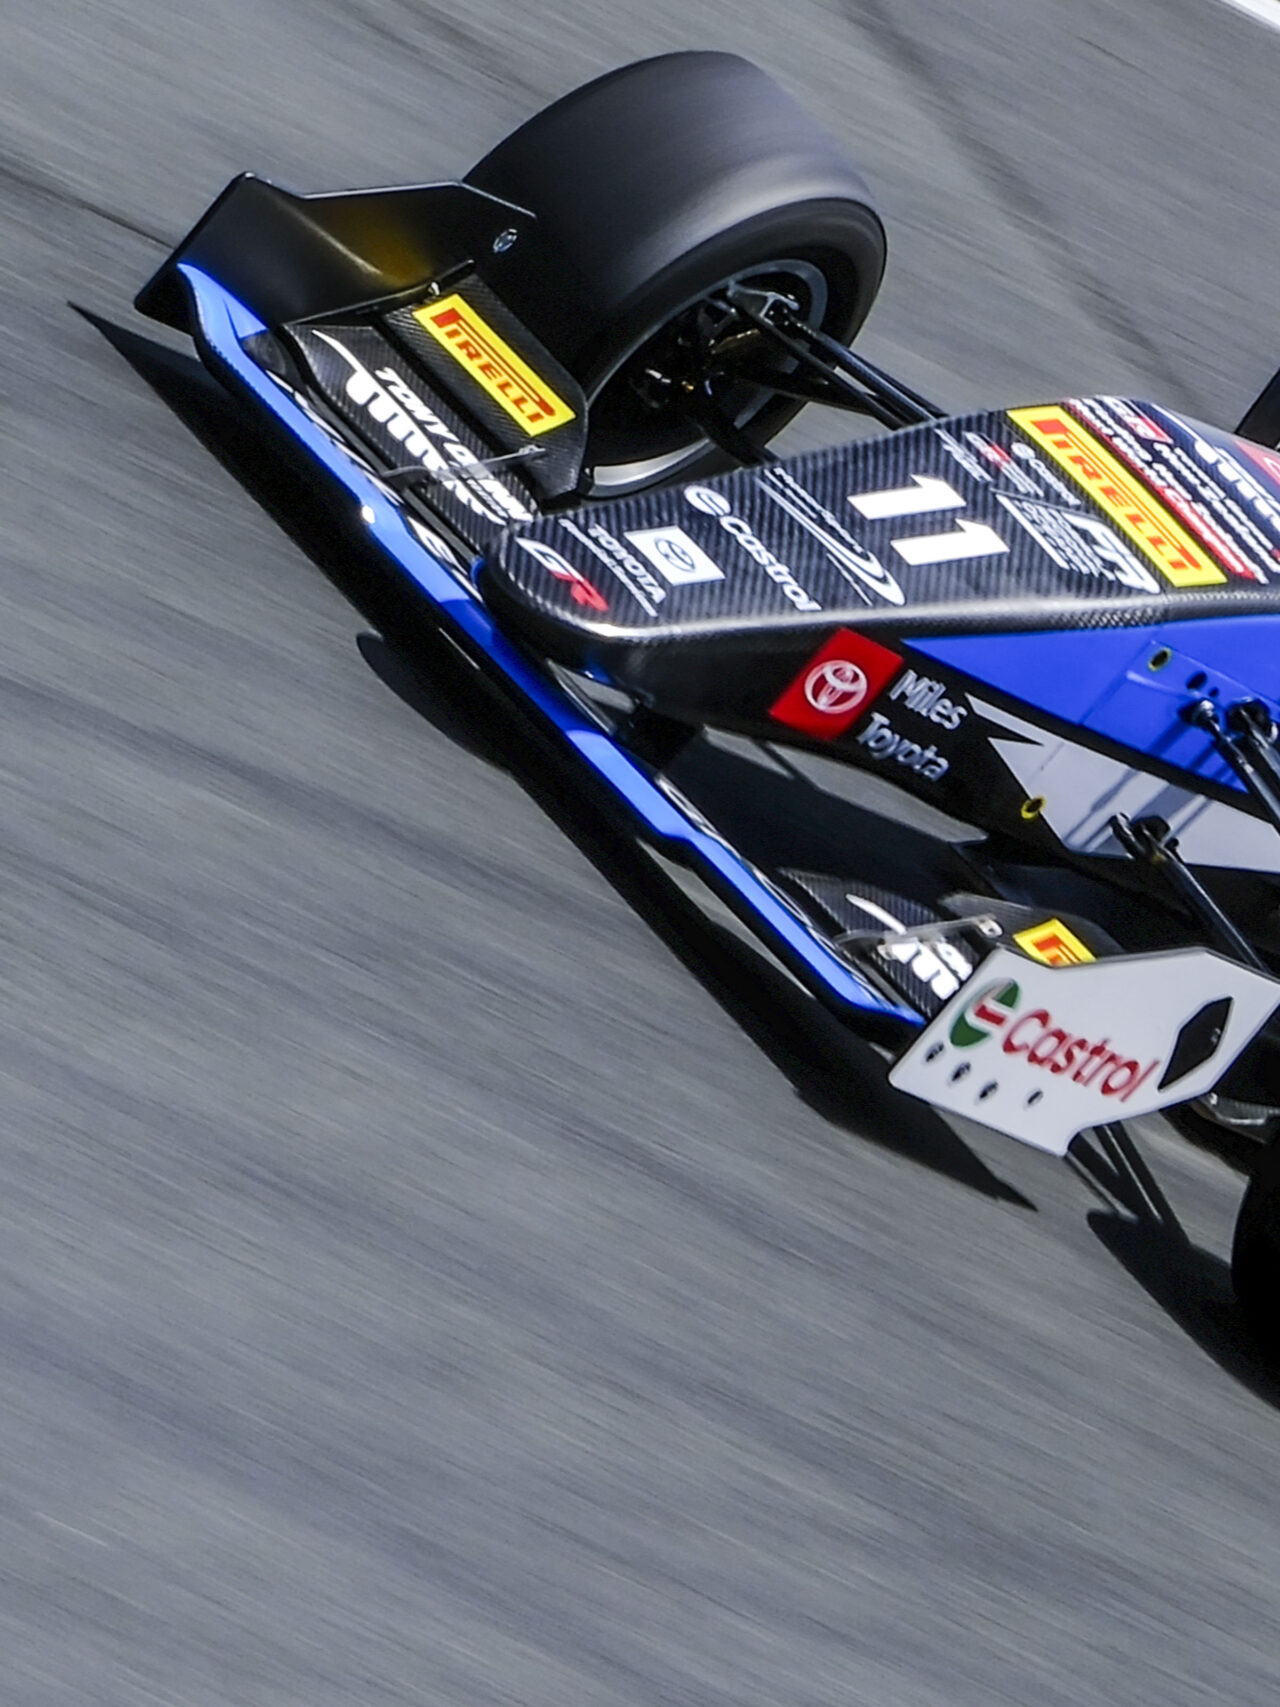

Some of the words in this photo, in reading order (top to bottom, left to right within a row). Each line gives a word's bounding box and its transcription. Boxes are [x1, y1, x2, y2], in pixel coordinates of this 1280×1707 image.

[374, 367, 460, 444] TONY
[432, 307, 556, 424] PIRELLI
[846, 473, 1011, 567] 11
[1030, 418, 1203, 570] PIRELLI
[516, 536, 609, 612] GR
[588, 523, 666, 604] TOYOTA
[720, 515, 823, 612] Castrol
[889, 670, 968, 732] Miles
[856, 713, 950, 781] Toyota
[1001, 1008, 1160, 1103] Castrol
